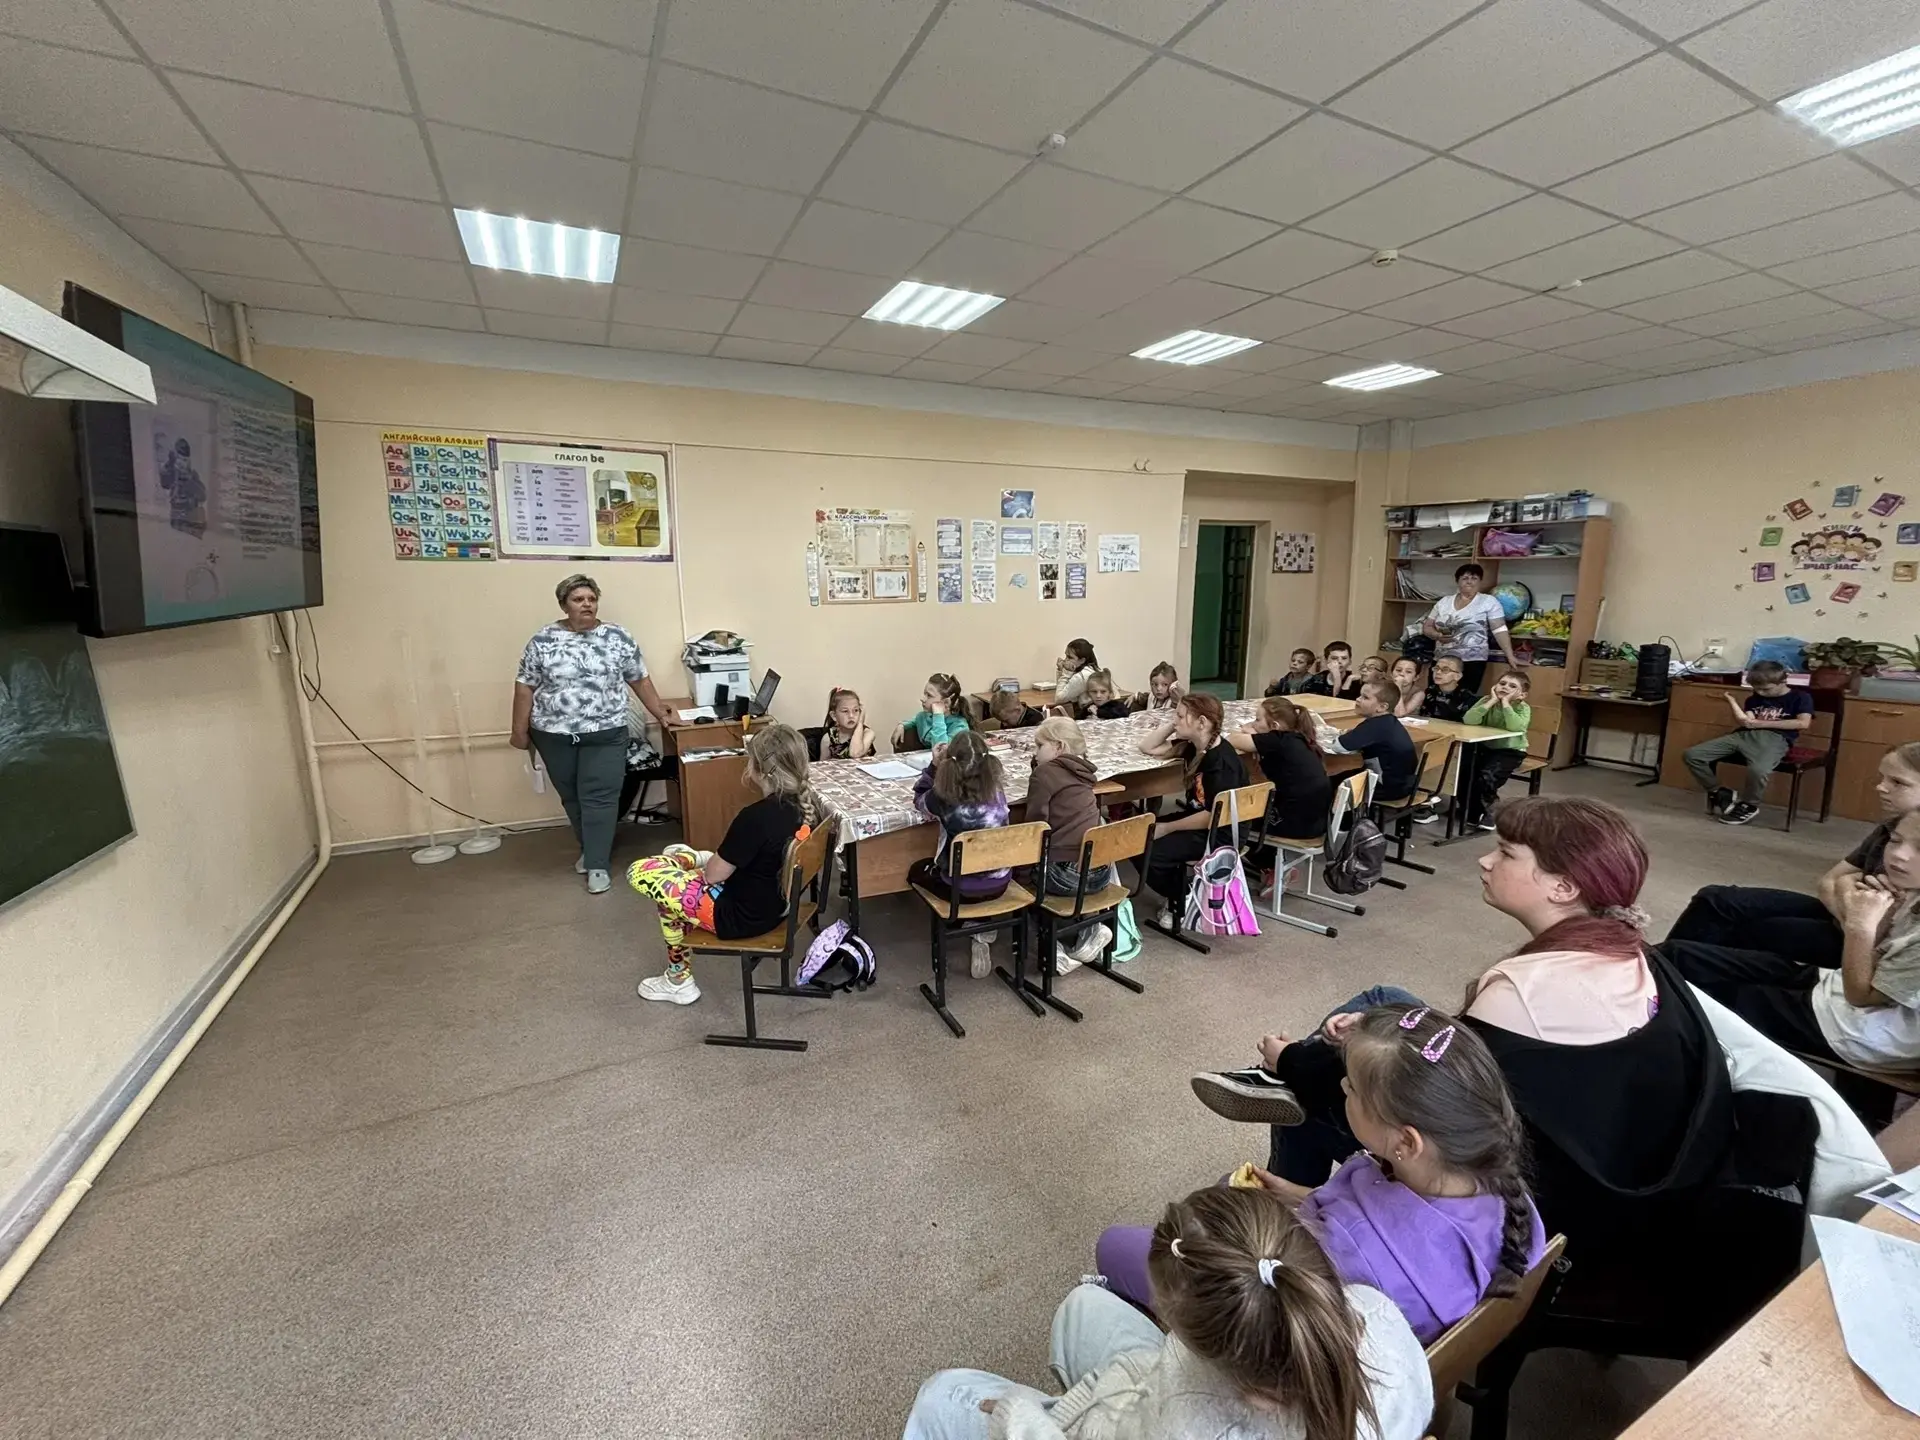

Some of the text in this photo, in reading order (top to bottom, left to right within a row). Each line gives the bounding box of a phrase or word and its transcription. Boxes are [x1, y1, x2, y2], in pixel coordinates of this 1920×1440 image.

[383, 433, 484, 445] АНГЛИЙСКИЙ АЛФАВИТ
[386, 446, 403, 455] Aa
[414, 447, 429, 456] Bb
[463, 450, 478, 458] Dd
[554, 453, 604, 463] ГЛАГОЛ be
[388, 462, 480, 476] Ee Ff Gg Hh
[420, 480, 429, 491] Jj
[442, 481, 457, 490] Kk
[443, 497, 460, 506] Oo
[421, 513, 434, 521] Rr
[421, 529, 436, 537] Vv
[472, 530, 485, 538] Xx
[398, 544, 413, 555] Yy
[425, 545, 439, 553] Zz
